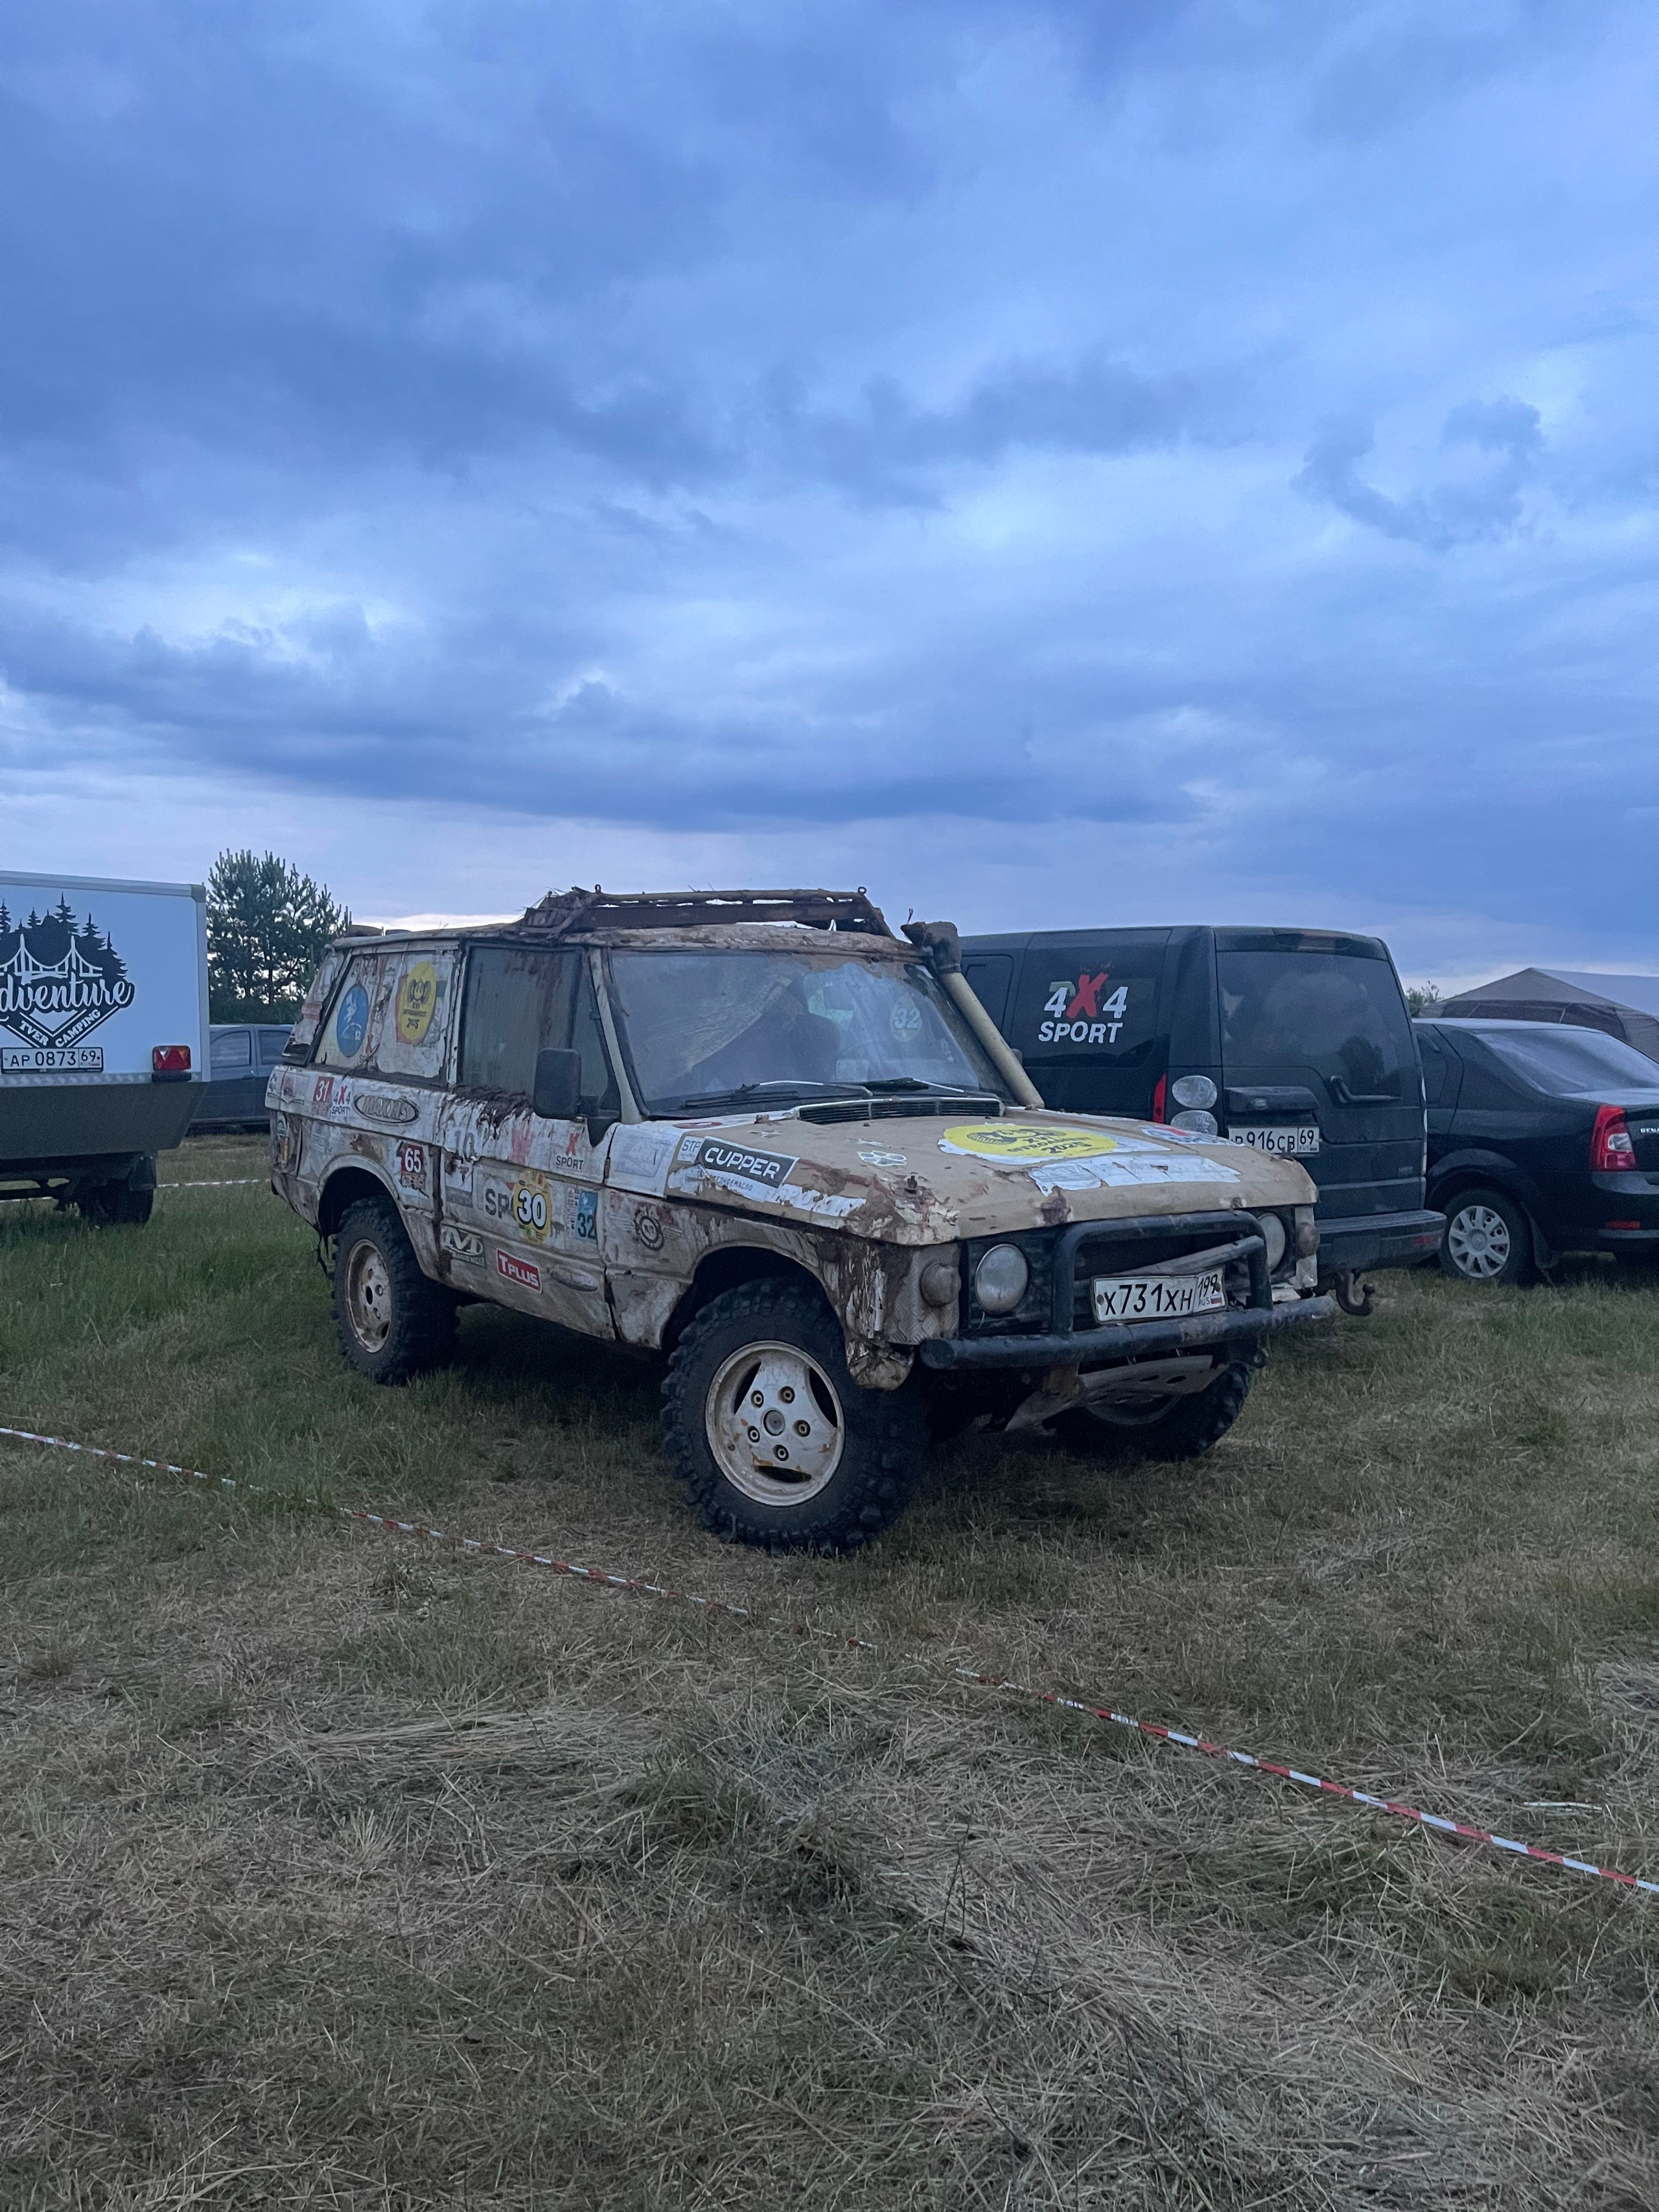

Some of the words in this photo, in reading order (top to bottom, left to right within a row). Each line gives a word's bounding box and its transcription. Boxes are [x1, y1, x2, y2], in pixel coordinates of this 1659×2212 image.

[0, 972, 132, 1012] dventure
[54, 1008, 101, 1047] CAMPING
[894, 1007, 921, 1029] 32
[19, 1020, 49, 1046] TVER
[1038, 1021, 1124, 1043] SPORT
[35, 1051, 76, 1066] 0873
[80, 1049, 97, 1062] 69
[316, 1080, 330, 1102] 31
[331, 1105, 351, 1115] SPORT
[1299, 1130, 1315, 1145] 69
[404, 1147, 422, 1174] 65
[555, 1155, 584, 1170] SPORT
[704, 1147, 780, 1180] CUPPER
[517, 1188, 547, 1230] 30
[577, 1212, 596, 1239] 32
[1198, 1274, 1220, 1298] 199
